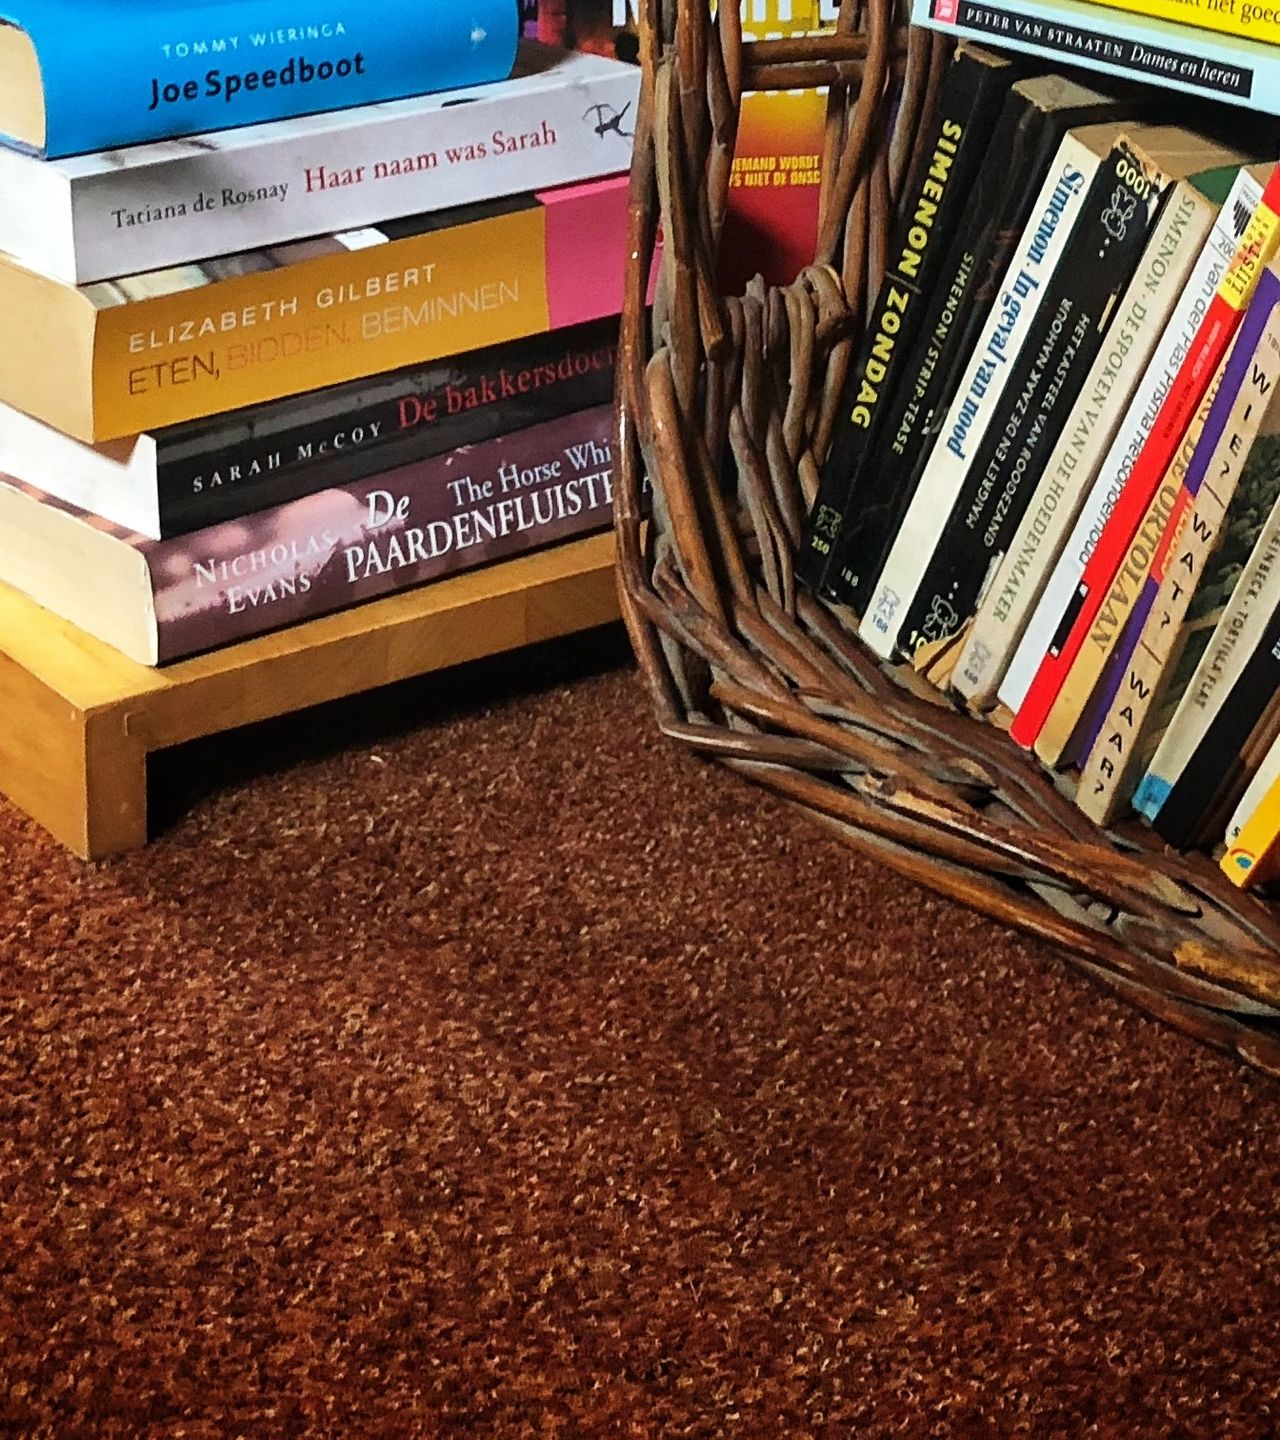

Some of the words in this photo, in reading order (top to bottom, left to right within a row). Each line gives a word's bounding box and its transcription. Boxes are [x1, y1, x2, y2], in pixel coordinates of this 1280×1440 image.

[161, 36, 238, 58] TOMMY
[249, 22, 346, 47] WIERINGA
[966, 7, 1010, 30] PETER
[1015, 19, 1043, 38] VAN
[1047, 28, 1123, 58] STRAATEN
[1130, 45, 1179, 72] Dames
[1179, 61, 1198, 77] en
[1199, 59, 1241, 88] heren
[148, 78, 199, 111] Joe
[205, 52, 366, 103] Speedboot
[303, 165, 366, 193] Haar
[373, 152, 438, 180] naam
[444, 142, 487, 164] was
[492, 119, 557, 156] Sarah
[1115, 158, 1151, 201] 1000
[110, 203, 187, 229] Tatiana
[193, 191, 215, 212] de
[217, 183, 288, 208] Rosnay
[897, 119, 962, 278] SIMENON
[1144, 193, 1196, 294] SIMENON
[1012, 269, 1040, 299] In
[1201, 262, 1225, 298] van
[129, 296, 298, 353] ELIZABETH
[316, 263, 436, 309] GILBERT
[986, 291, 1022, 364] geval
[1071, 313, 1090, 348] HET
[1125, 301, 1147, 332] DE
[1187, 297, 1214, 336] der
[128, 350, 220, 396] ETEN,
[358, 277, 523, 340] BEMINNEN
[851, 286, 910, 428] ZONDAG
[969, 358, 997, 398] van
[1040, 344, 1076, 410] KASTEEL
[1091, 332, 1134, 408] SPOKEN
[398, 397, 437, 429] De
[946, 395, 980, 461] nood
[965, 458, 1000, 529] MAIGRET
[995, 436, 1012, 460] EN
[1005, 413, 1022, 438] DE
[1015, 368, 1042, 413] ZAAK
[1035, 298, 1073, 369] NAHOUR
[1026, 413, 1047, 448] VAN
[1070, 410, 1100, 452] VAN
[193, 452, 280, 493] SARAH
[1056, 448, 1083, 481] DE
[1171, 435, 1204, 483] DE
[361, 490, 410, 530] De
[446, 476, 494, 506] The
[497, 460, 561, 493] Horse
[983, 446, 1032, 547] ROODEZAND
[189, 543, 339, 581] NICHOLAS
[992, 478, 1065, 624] HOEDENMAKER
[1090, 478, 1183, 654] ORTOLAAN
[222, 567, 311, 614] EVANS
[1210, 611, 1249, 674] TORTILLA
[1192, 673, 1217, 709] FLAT
